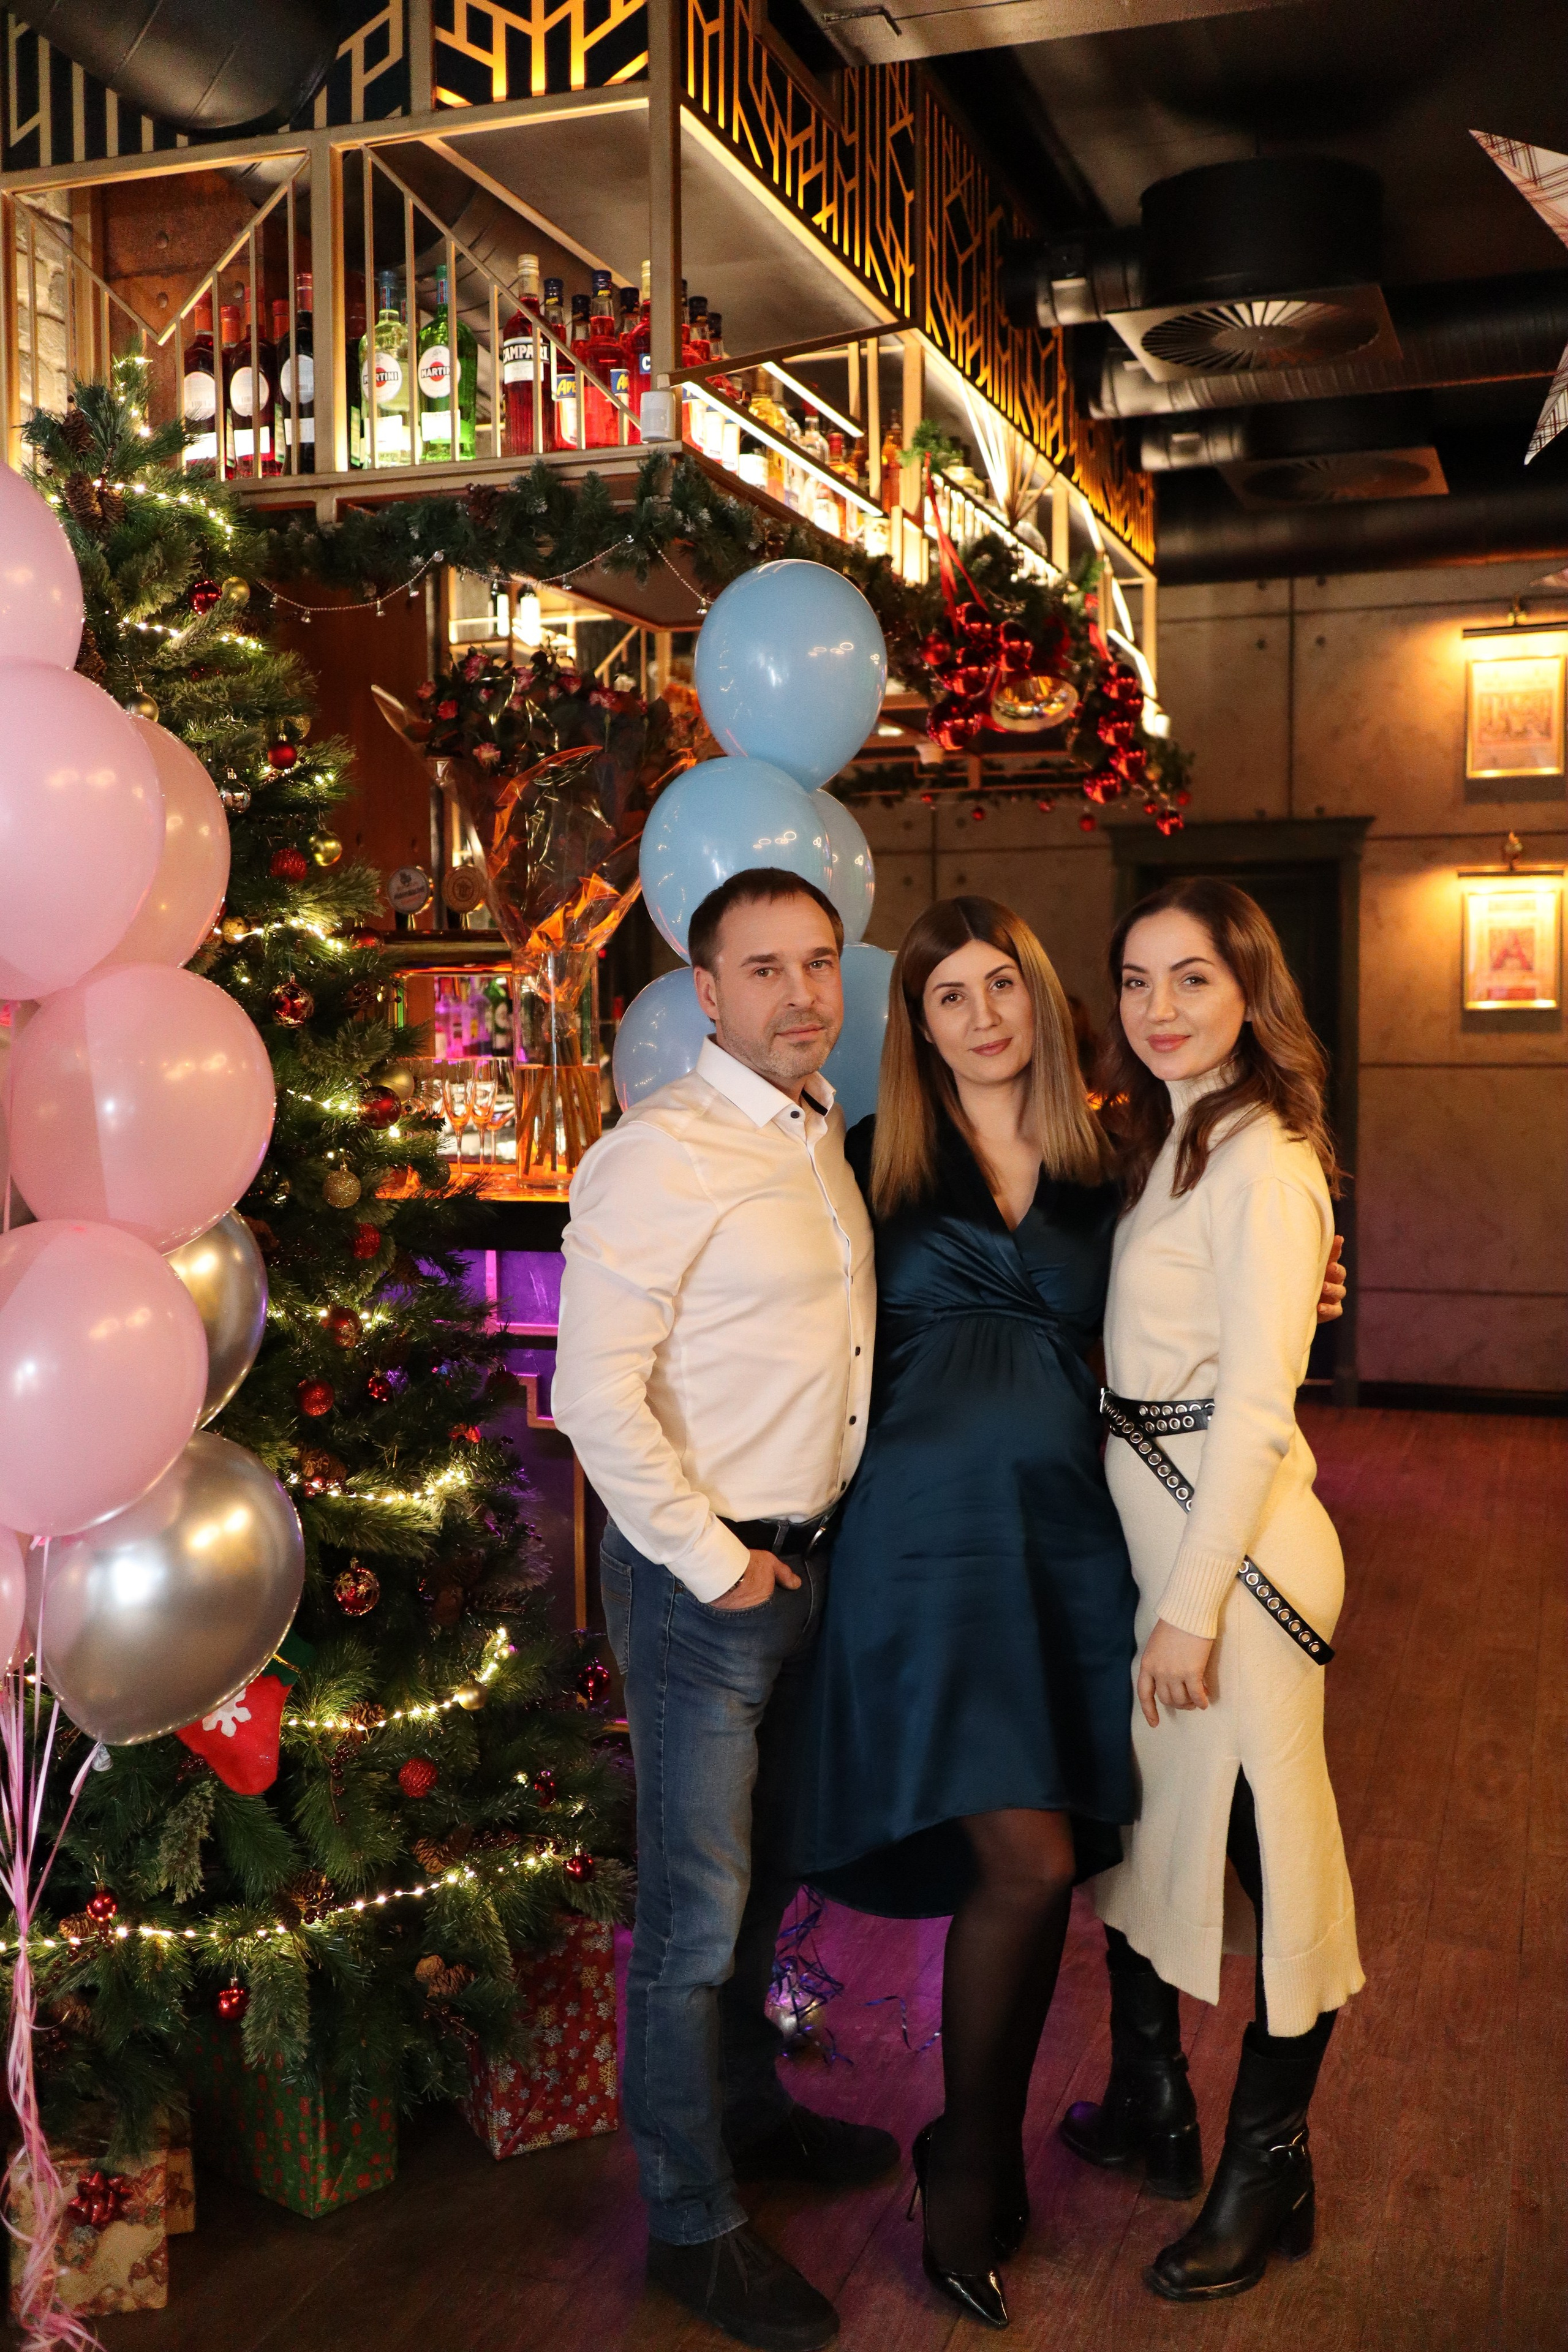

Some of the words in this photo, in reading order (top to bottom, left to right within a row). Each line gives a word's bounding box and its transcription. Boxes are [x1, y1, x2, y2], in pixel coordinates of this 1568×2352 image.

[503, 344, 549, 363] AMPAI
[363, 371, 399, 384] MRTINI
[421, 366, 450, 378] MARTIN
[557, 379, 576, 396] APE
